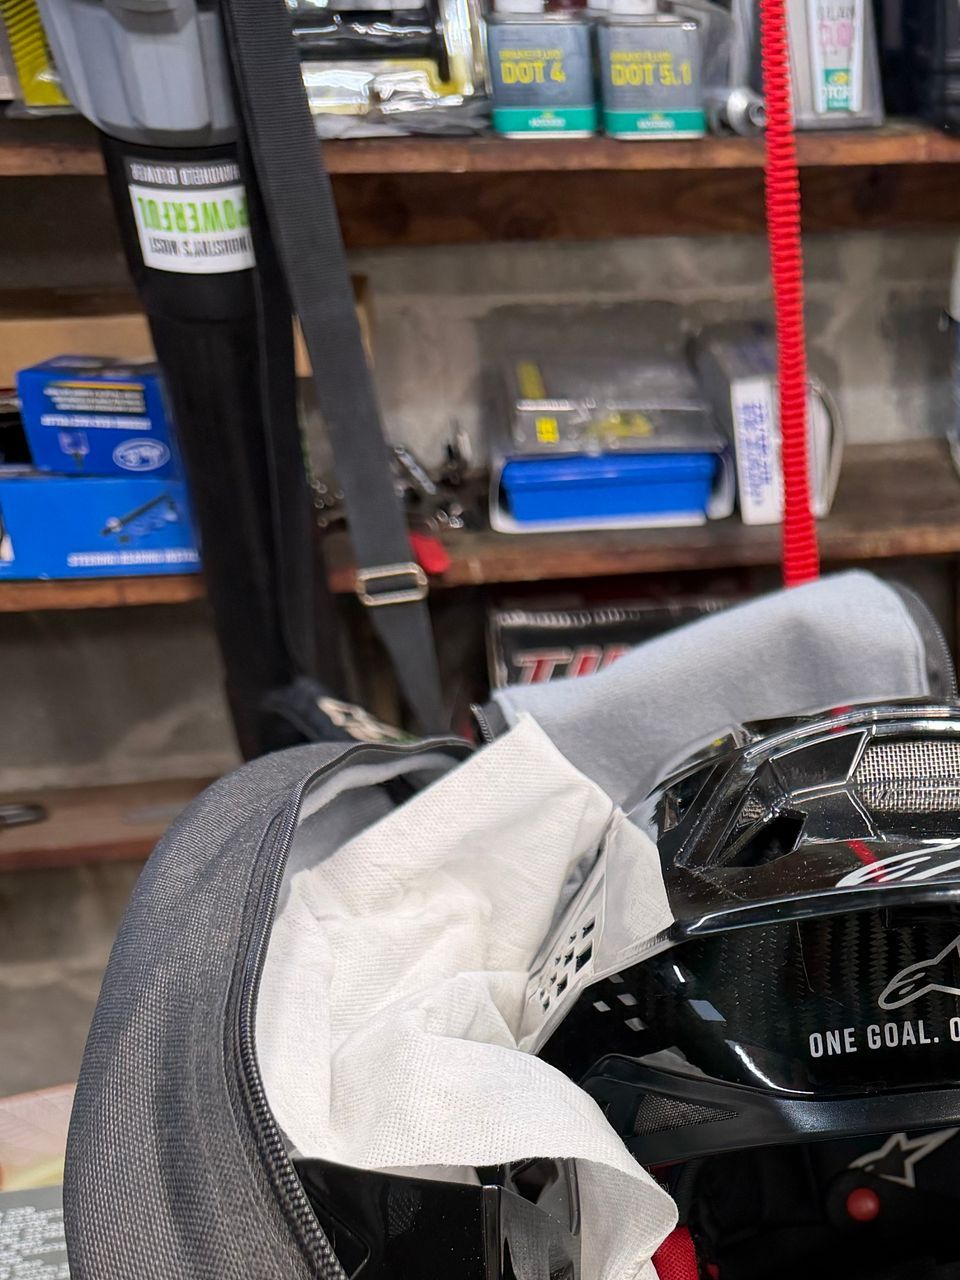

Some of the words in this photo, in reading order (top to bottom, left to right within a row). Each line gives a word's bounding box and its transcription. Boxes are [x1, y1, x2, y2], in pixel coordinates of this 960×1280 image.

[501, 61, 545, 85] DOT
[550, 61, 566, 83] 4
[611, 63, 654, 86] DOT
[659, 63, 692, 86] 5.1
[138, 196, 250, 234] POWERFUL
[808, 1026, 858, 1058] ONE
[866, 1019, 940, 1050] GOAL.
